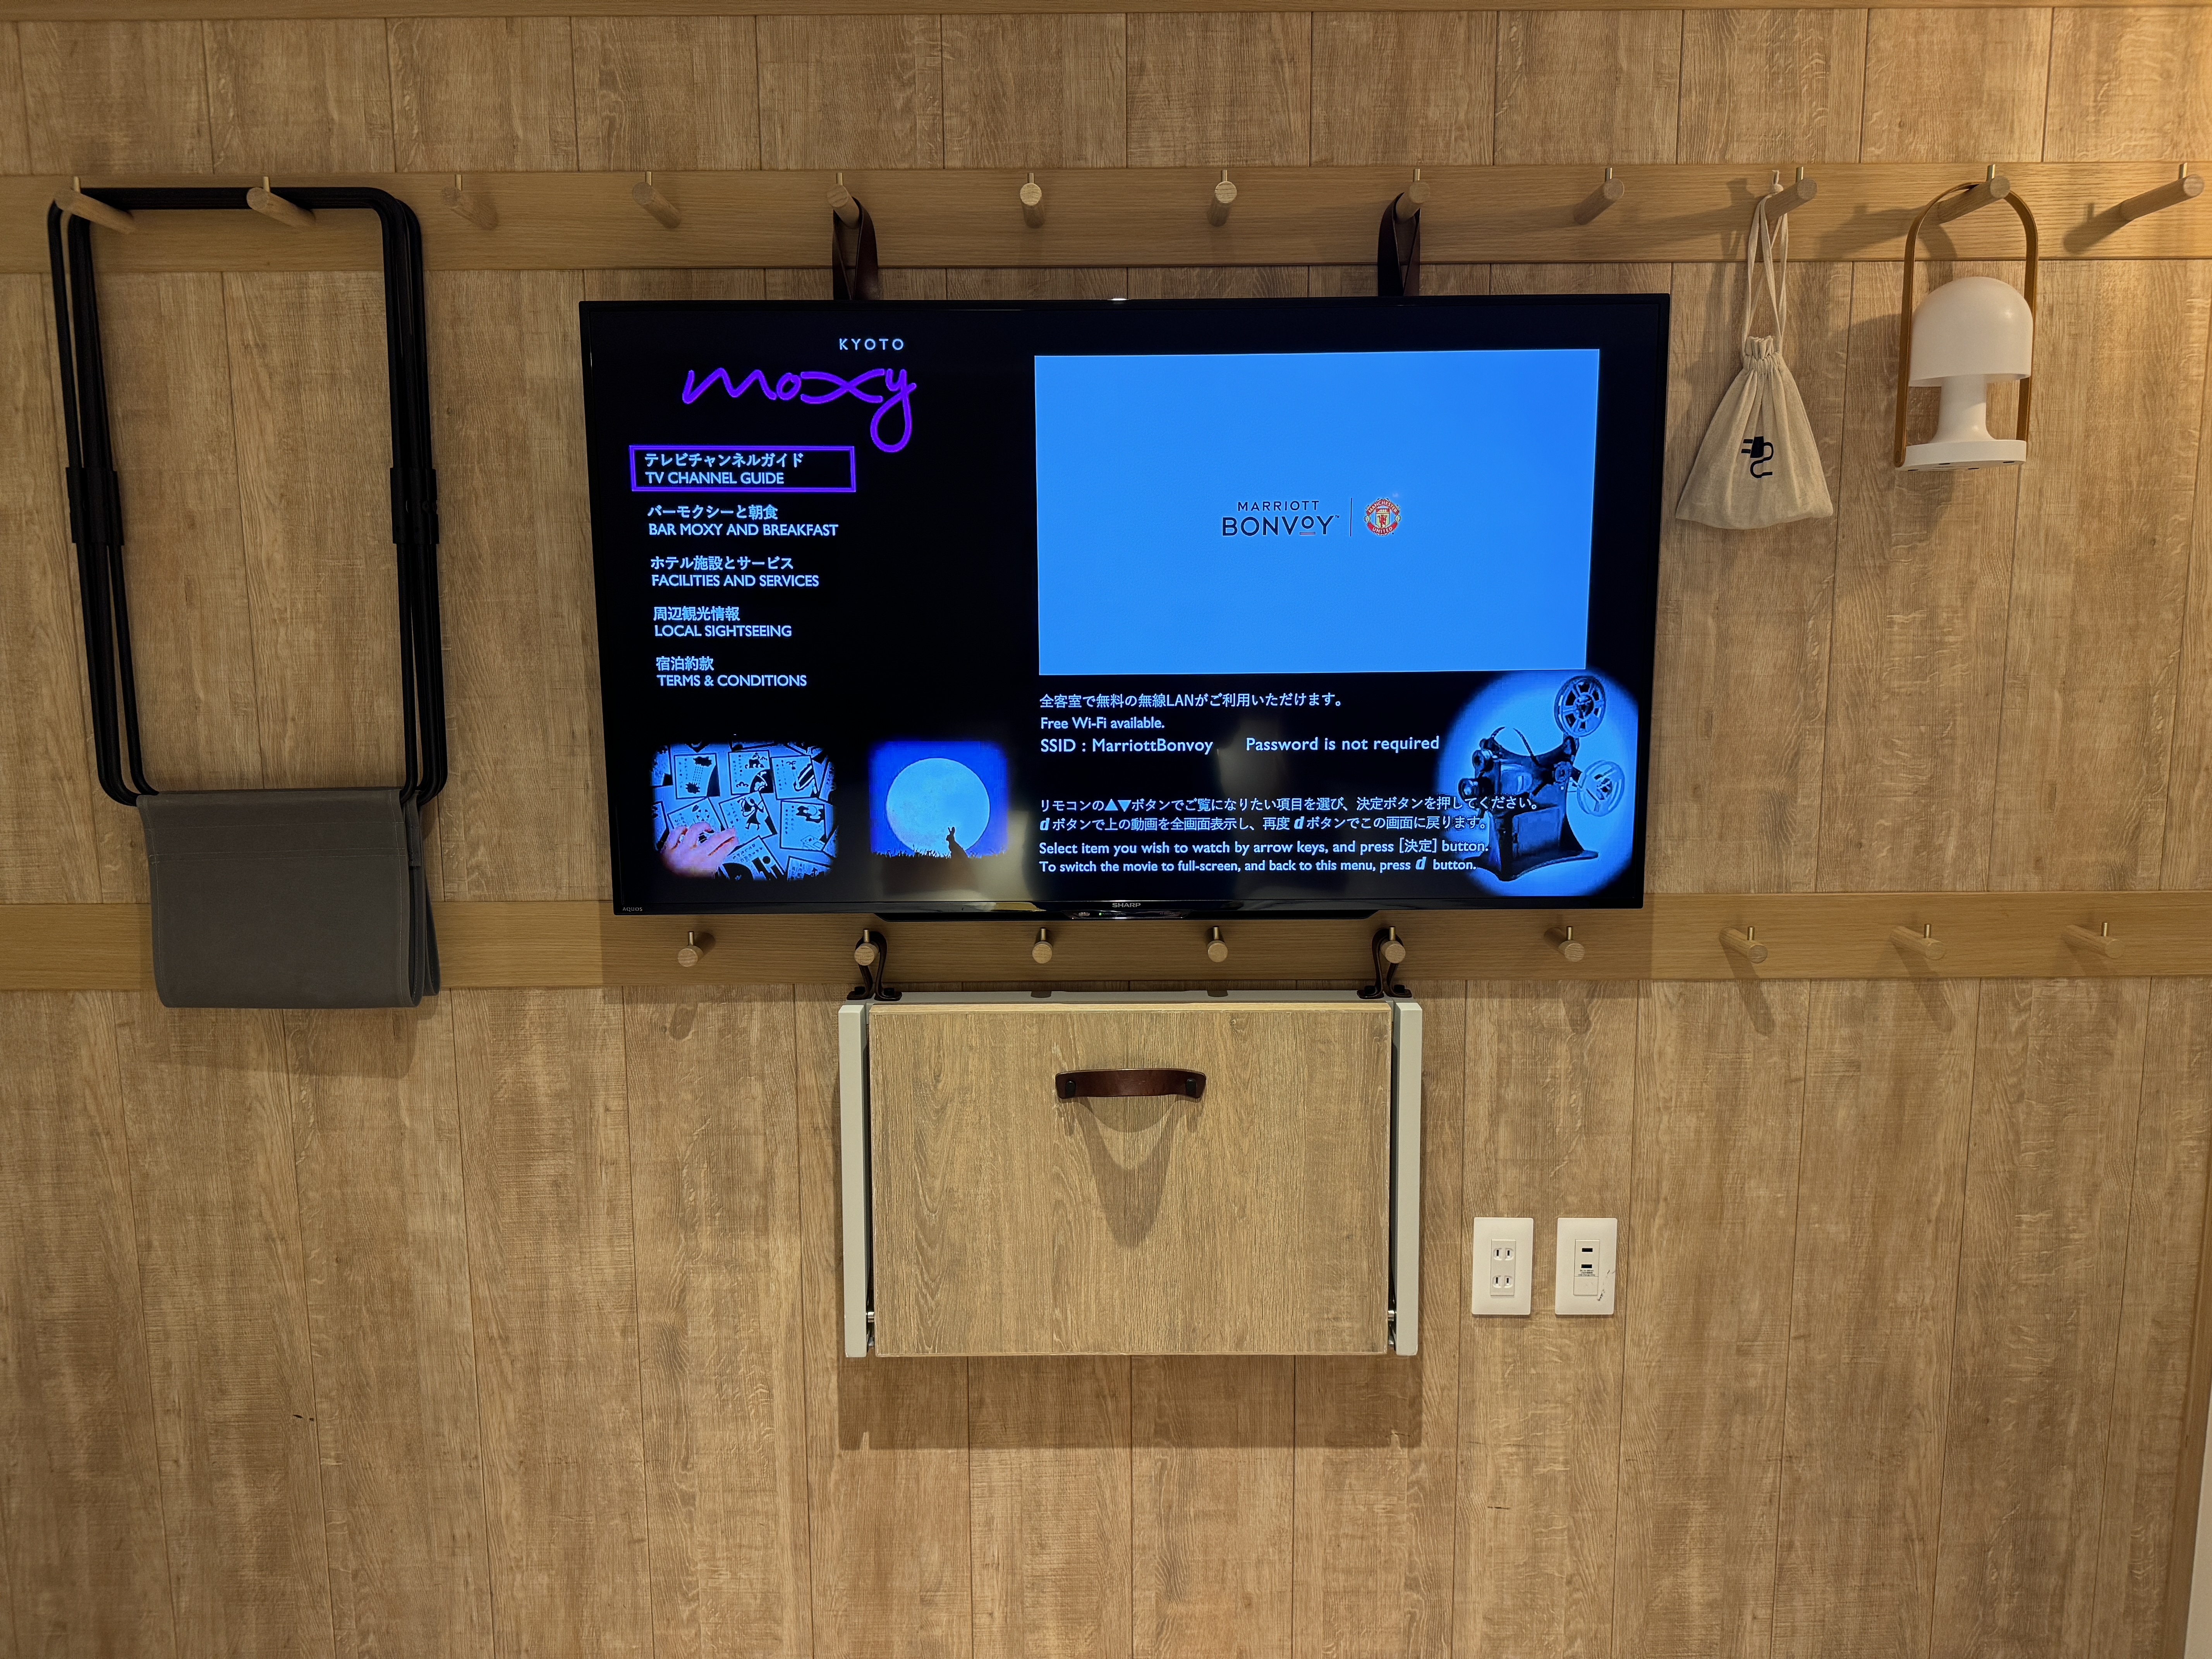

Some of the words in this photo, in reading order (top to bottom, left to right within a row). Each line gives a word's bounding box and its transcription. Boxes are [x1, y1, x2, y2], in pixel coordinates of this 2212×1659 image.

[840, 338, 903, 350] KYOTO
[645, 453, 804, 467] テレビチャンネルガイド
[645, 472, 664, 484] TV
[668, 472, 737, 484] CHANNEL
[740, 472, 784, 484] GUIDE
[647, 504, 778, 520] バーモクシーと朝食
[1238, 501, 1319, 511] MARRIOTT
[649, 523, 677, 535] BAR
[680, 524, 723, 536] MOXY
[726, 524, 759, 536] AND
[763, 524, 838, 536] BREAKFAST
[651, 555, 793, 571] ホテル施設とサービス
[652, 574, 720, 586] FACILITIES
[723, 575, 756, 586] AND
[759, 575, 819, 587] SERVICES
[653, 606, 740, 621] 周辺観光情報
[655, 625, 702, 637] LOCAL
[705, 625, 792, 637] SIGHTSEEING
[656, 656, 714, 671] 宿泊約款
[656, 675, 701, 686] TERMS
[704, 675, 714, 686] &
[717, 675, 807, 686] CONDITIONS
[1040, 692, 1341, 708] 全客室で無料の無線LANがご利用いただけます。
[1041, 717, 1068, 729] Free
[1072, 717, 1106, 728] Wi-Fi
[1111, 716, 1164, 728] available.
[1041, 738, 1076, 752] SSID
[1093, 738, 1213, 755] MarriottBonvoy
[1247, 737, 1318, 750] Password
[1325, 738, 1335, 750] is
[1342, 739, 1368, 750] not
[1374, 736, 1439, 753] required
[1039, 842, 1078, 854] Select
[1082, 843, 1109, 854] item
[1113, 845, 1137, 857] you
[1141, 842, 1170, 853] wish
[1174, 844, 1188, 853] to
[1192, 841, 1230, 853] watch
[1235, 841, 1250, 856] by
[1254, 844, 1293, 853] arrow
[1297, 841, 1328, 855] keys,
[1333, 840, 1355, 852] and
[1360, 844, 1394, 855] press
[1442, 840, 1488, 852] button.
[1039, 861, 1056, 872] To
[1060, 861, 1096, 872] switch
[1100, 861, 1119, 871] the
[1123, 861, 1158, 871] movie
[1161, 862, 1174, 871] to
[1178, 860, 1241, 872] full-screen,
[1245, 860, 1265, 871] and
[1269, 860, 1296, 871] back
[1299, 862, 1312, 871] to
[1316, 860, 1337, 870] this
[1341, 862, 1376, 871] menu,
[1380, 862, 1411, 873] press
[1433, 859, 1477, 871] button.
